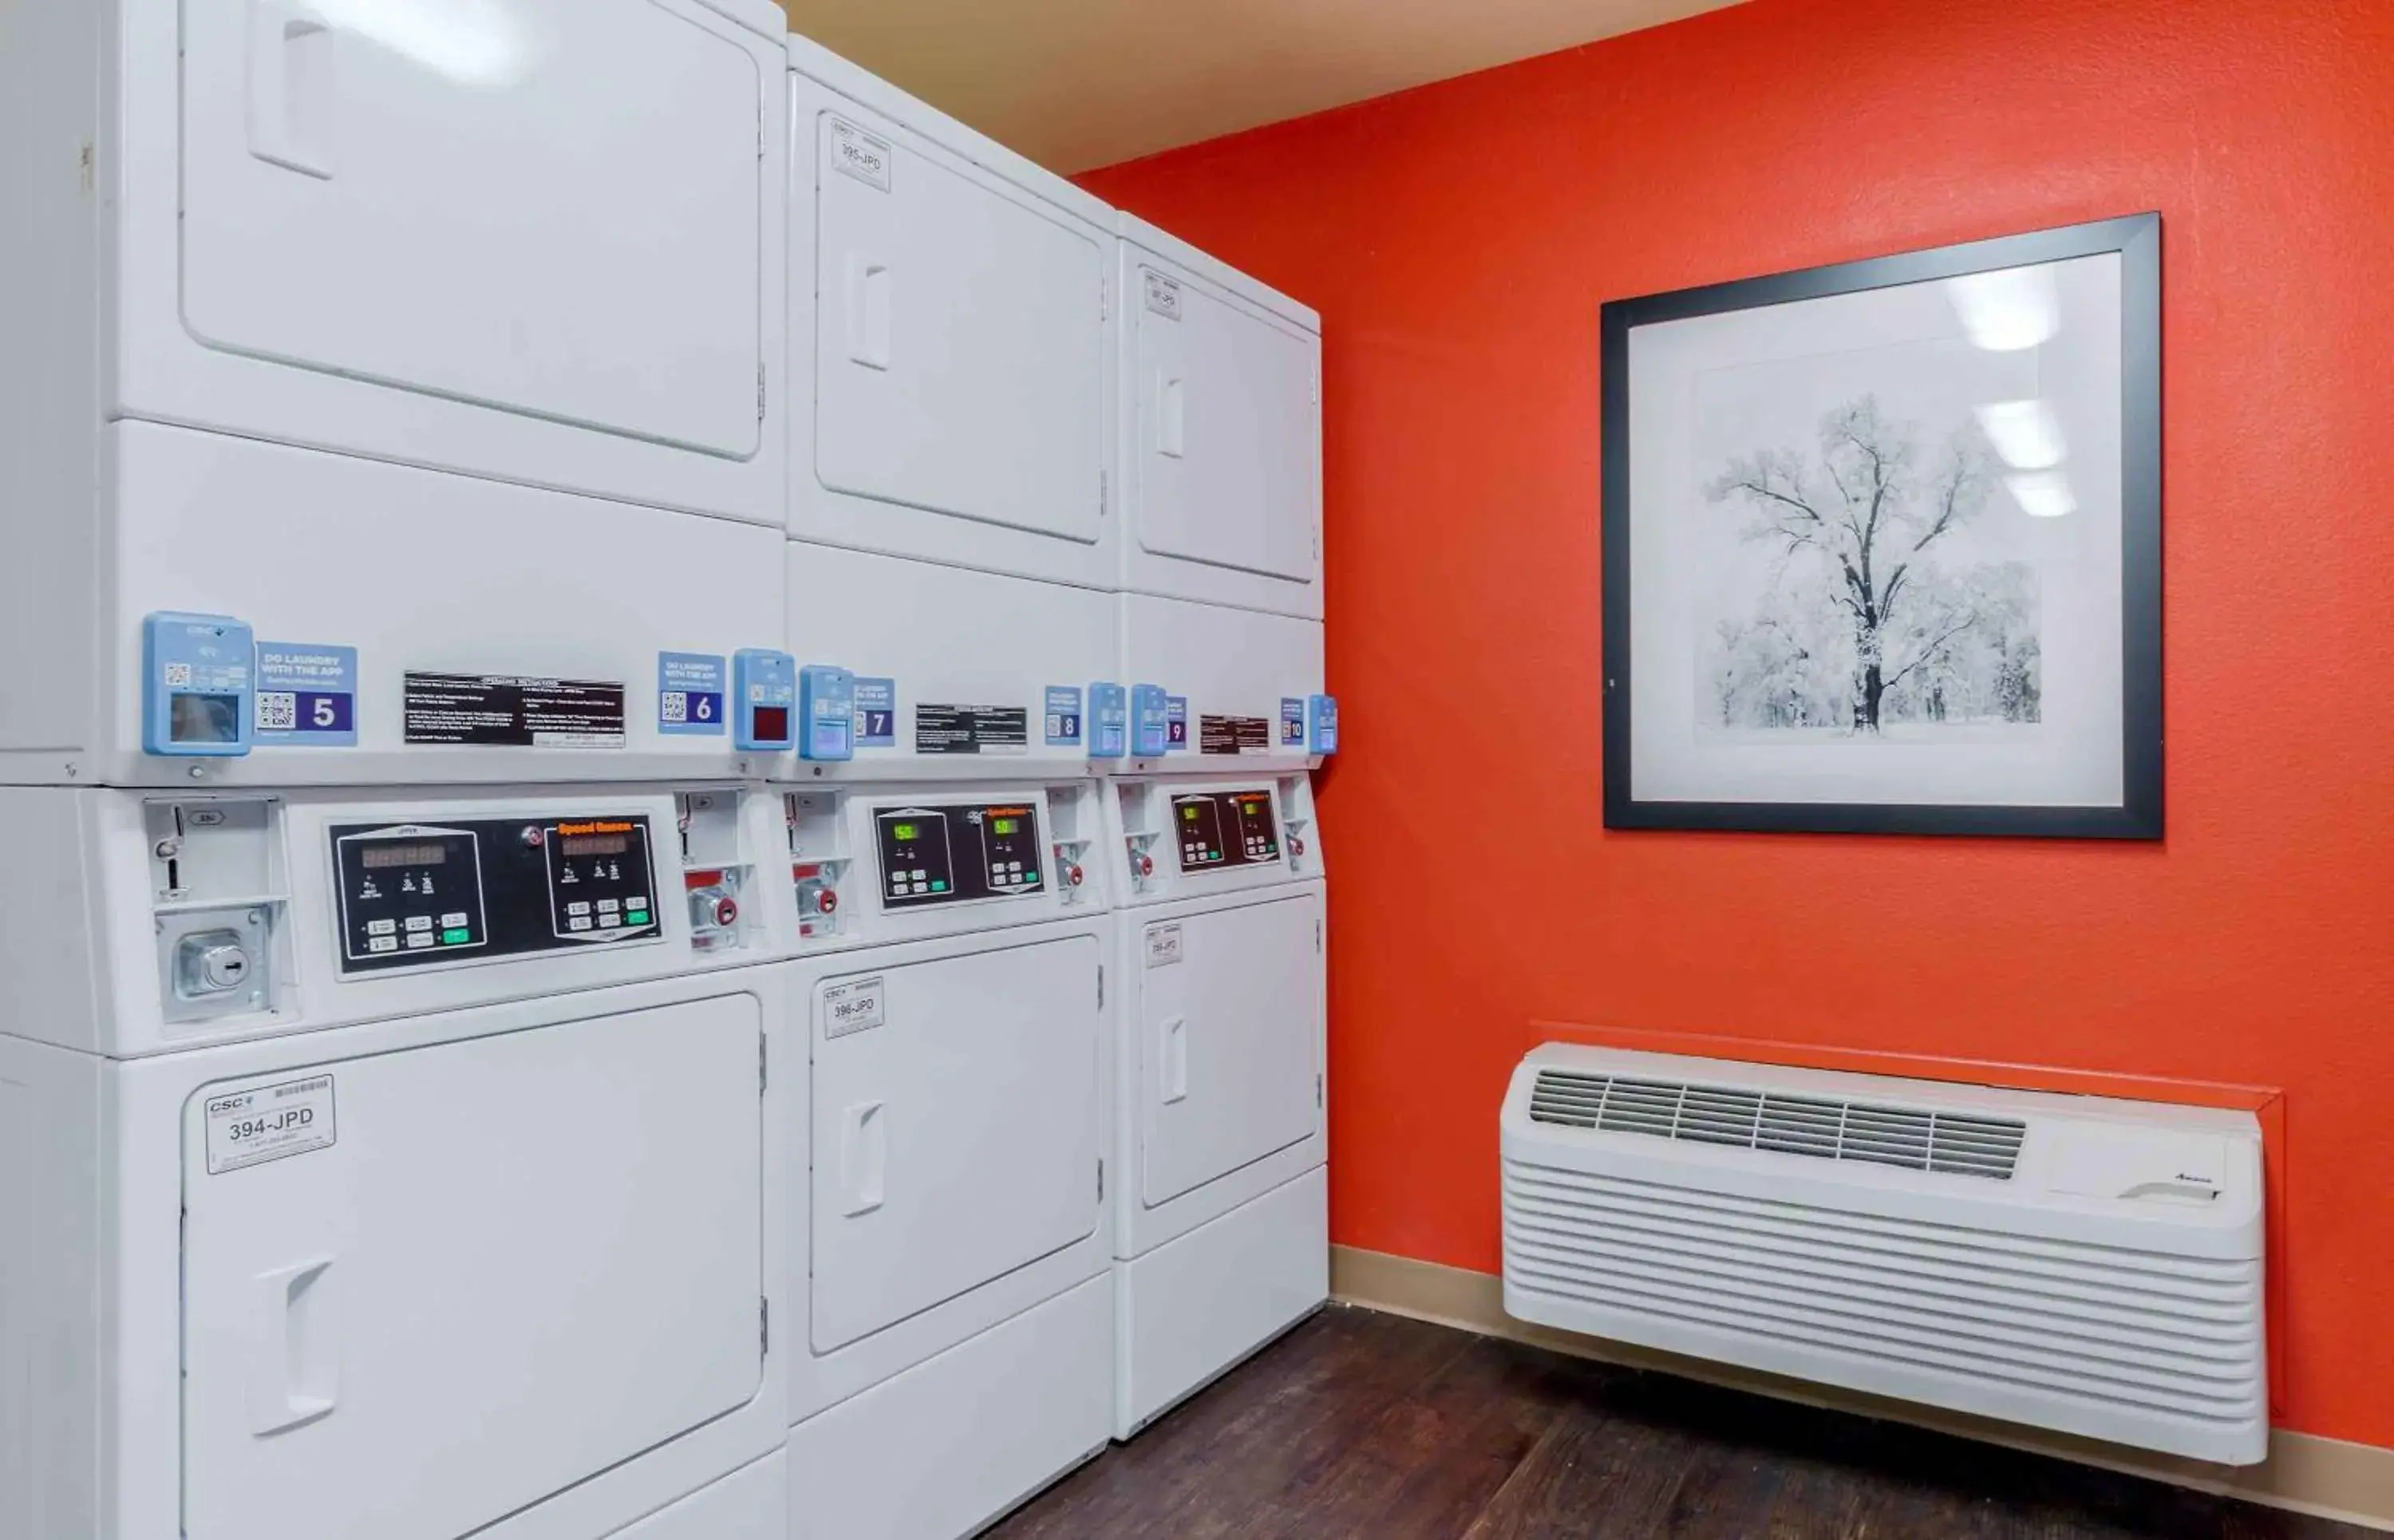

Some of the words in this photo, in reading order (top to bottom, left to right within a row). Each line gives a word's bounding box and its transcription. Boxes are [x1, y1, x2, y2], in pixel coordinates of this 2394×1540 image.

[265, 654, 282, 663] DO
[285, 654, 341, 666] LAUNDRY
[261, 664, 293, 676] WITH
[294, 665, 319, 676] THE
[320, 666, 344, 677] APP
[313, 698, 335, 727] 5
[697, 697, 712, 719] 6
[874, 714, 885, 734] 7
[1065, 717, 1074, 735] 8
[1291, 721, 1302, 736] 10
[1173, 725, 1181, 740] 9
[210, 1098, 243, 1112] CSC
[230, 1108, 314, 1140] 394-JPD
